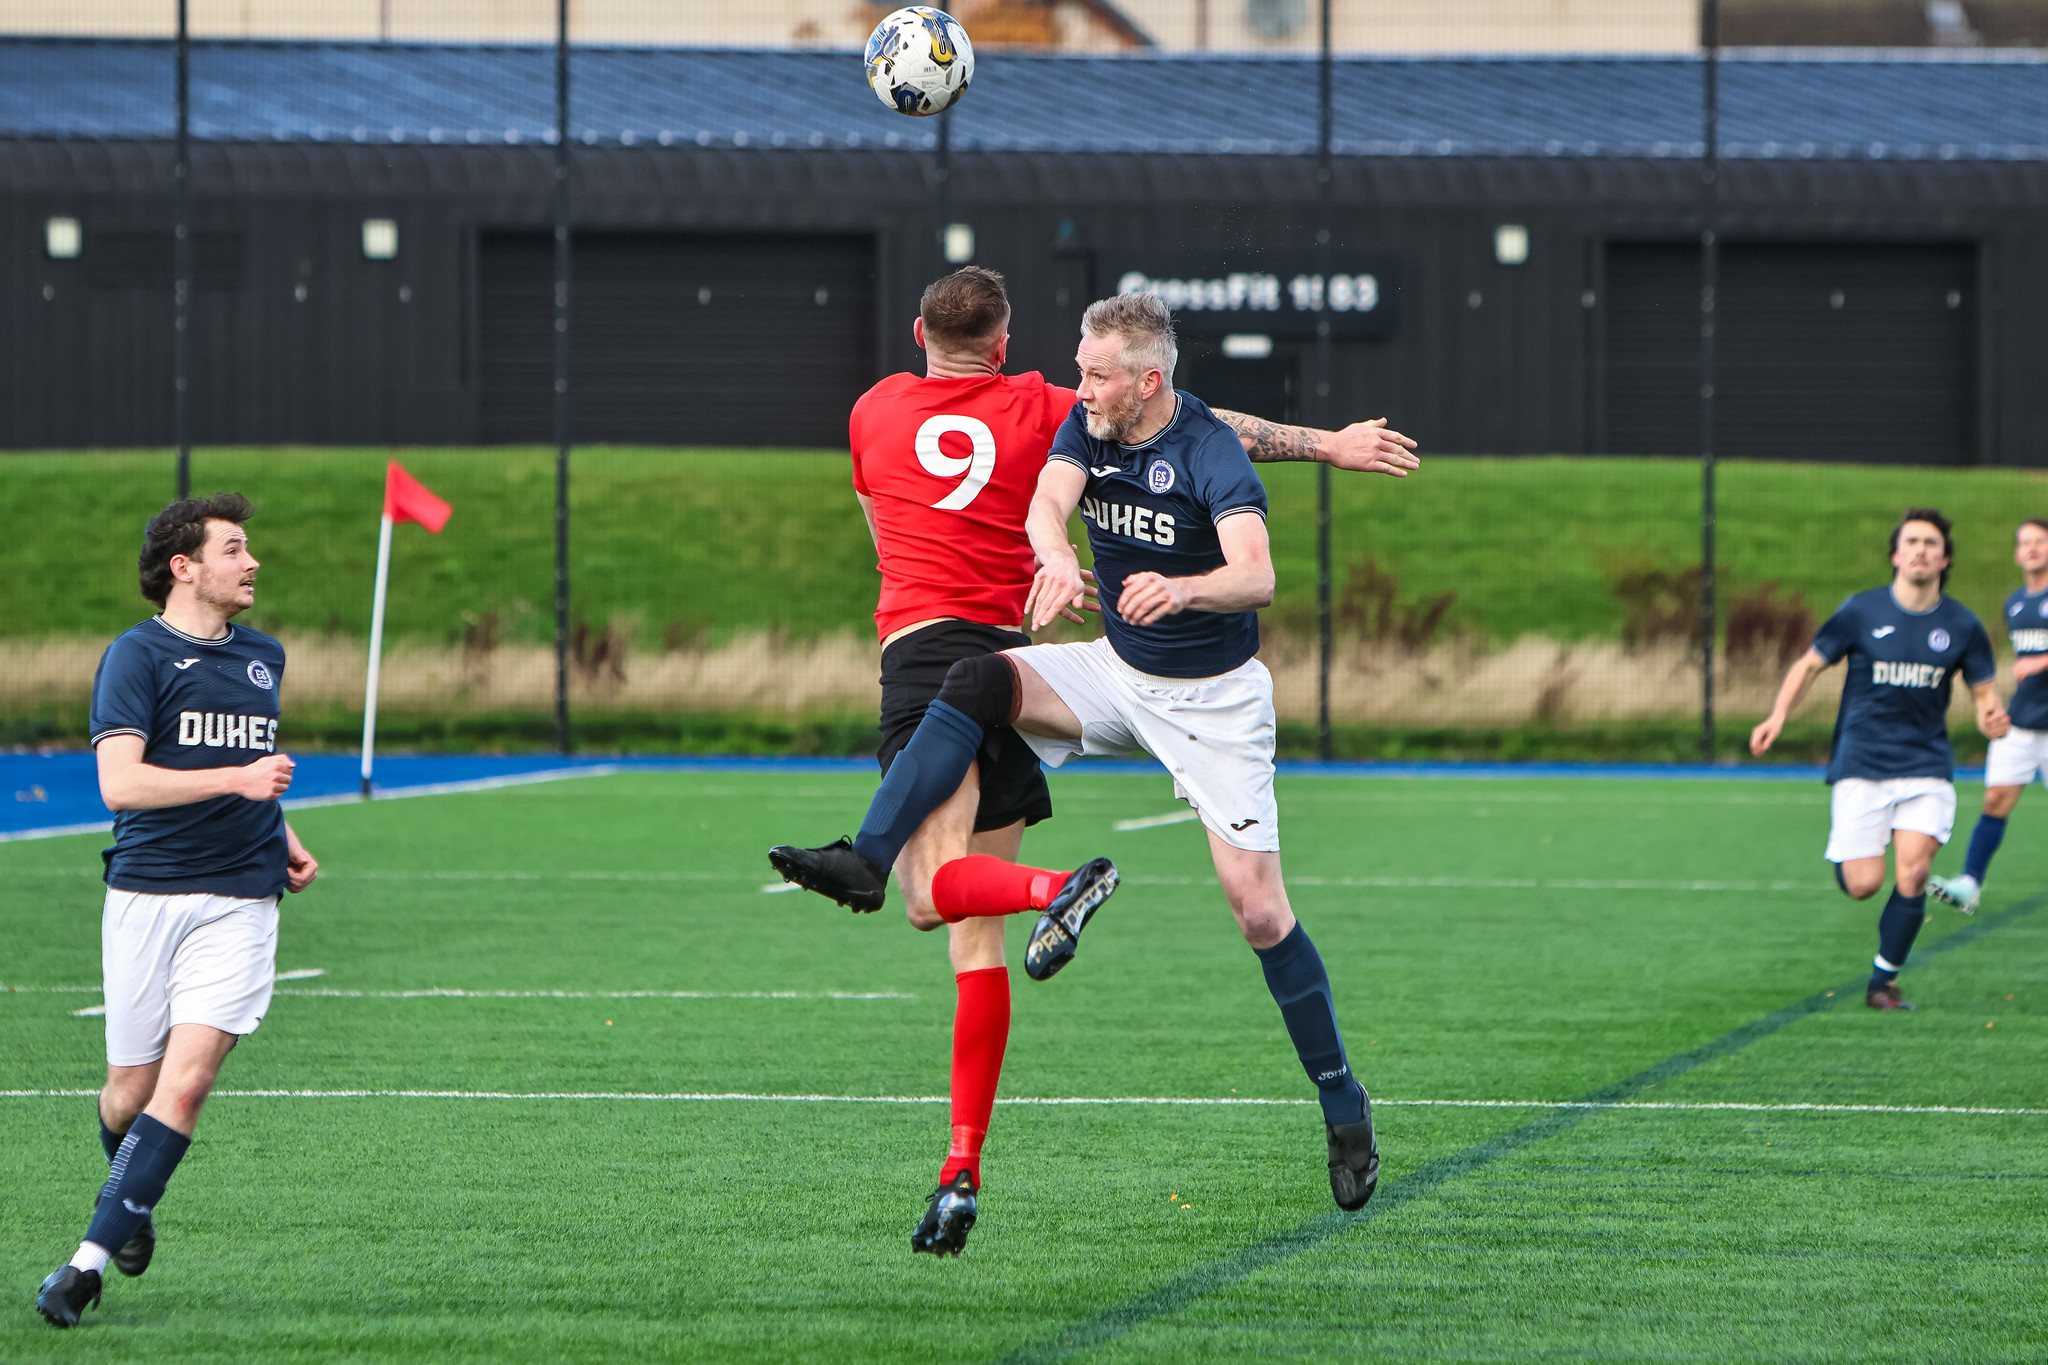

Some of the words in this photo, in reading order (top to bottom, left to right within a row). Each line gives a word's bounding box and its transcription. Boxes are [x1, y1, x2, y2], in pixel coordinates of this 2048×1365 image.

[914, 414, 996, 511] 9
[1872, 661, 1946, 690] DUKES
[178, 711, 279, 753] DUKES
